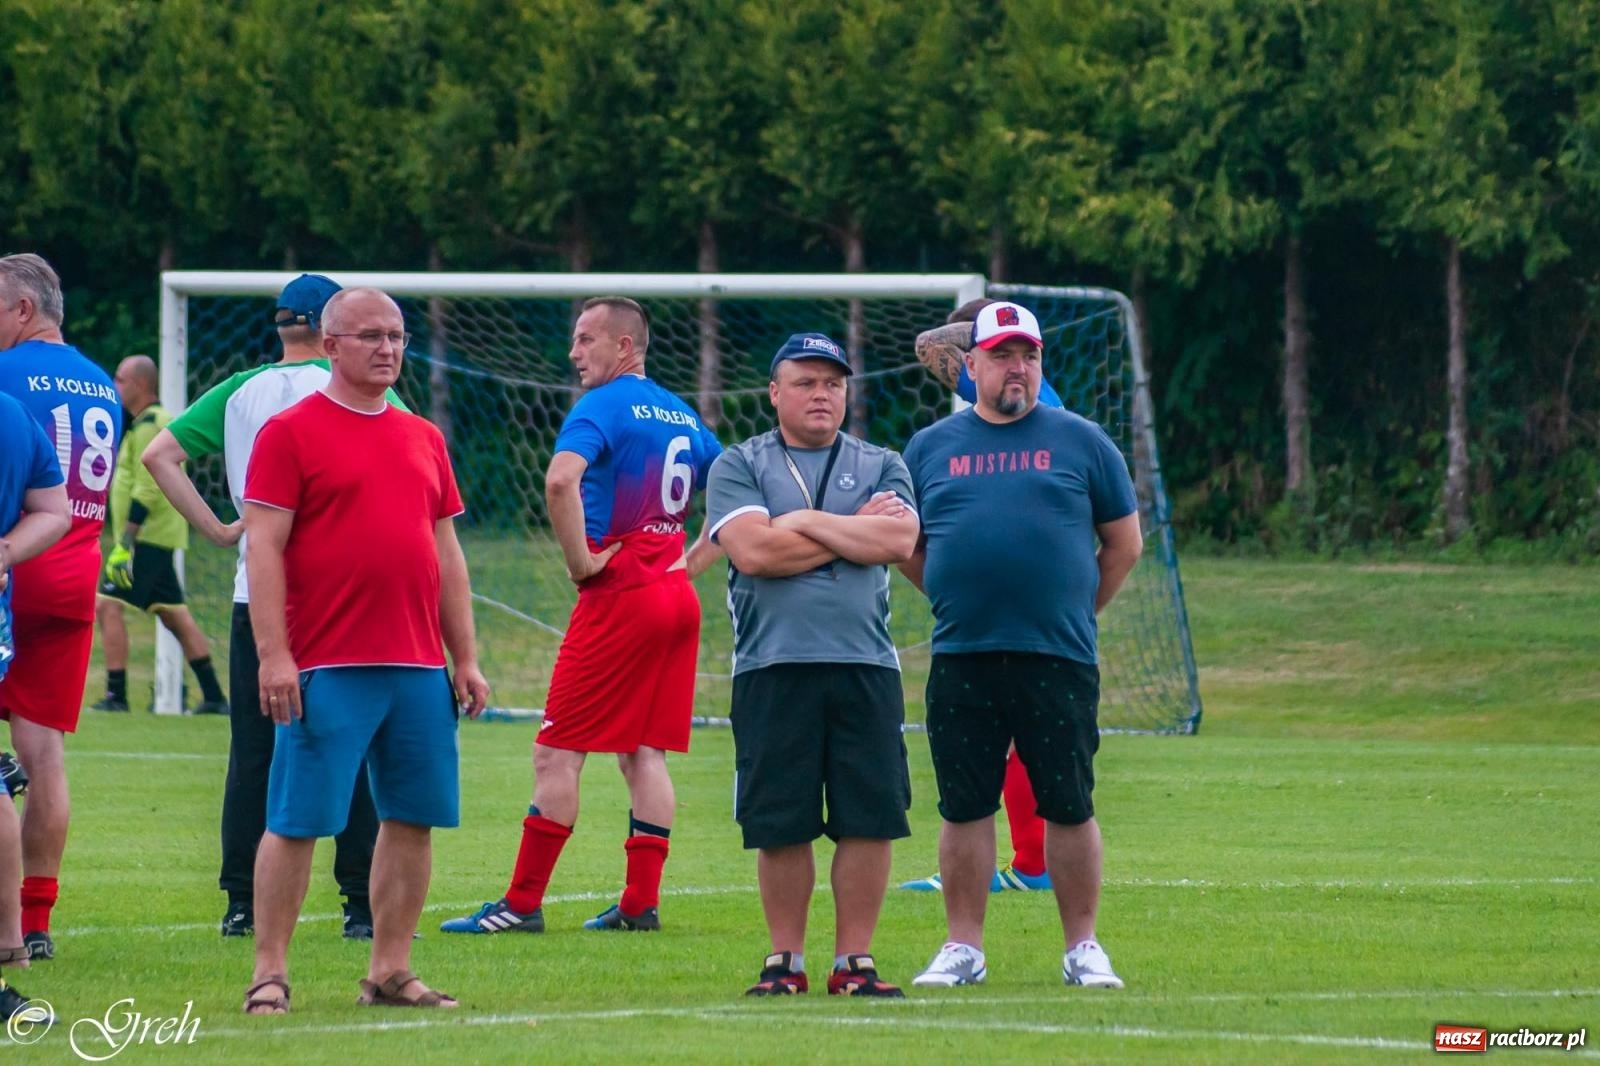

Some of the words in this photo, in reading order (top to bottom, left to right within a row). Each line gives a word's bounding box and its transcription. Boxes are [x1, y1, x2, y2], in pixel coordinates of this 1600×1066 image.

[28, 376, 51, 392] KS
[55, 377, 118, 404] KOLEJARZ
[632, 405, 652, 420] KS
[50, 403, 115, 492] 18
[661, 435, 692, 515] 6
[949, 449, 1051, 477] MUSTANG
